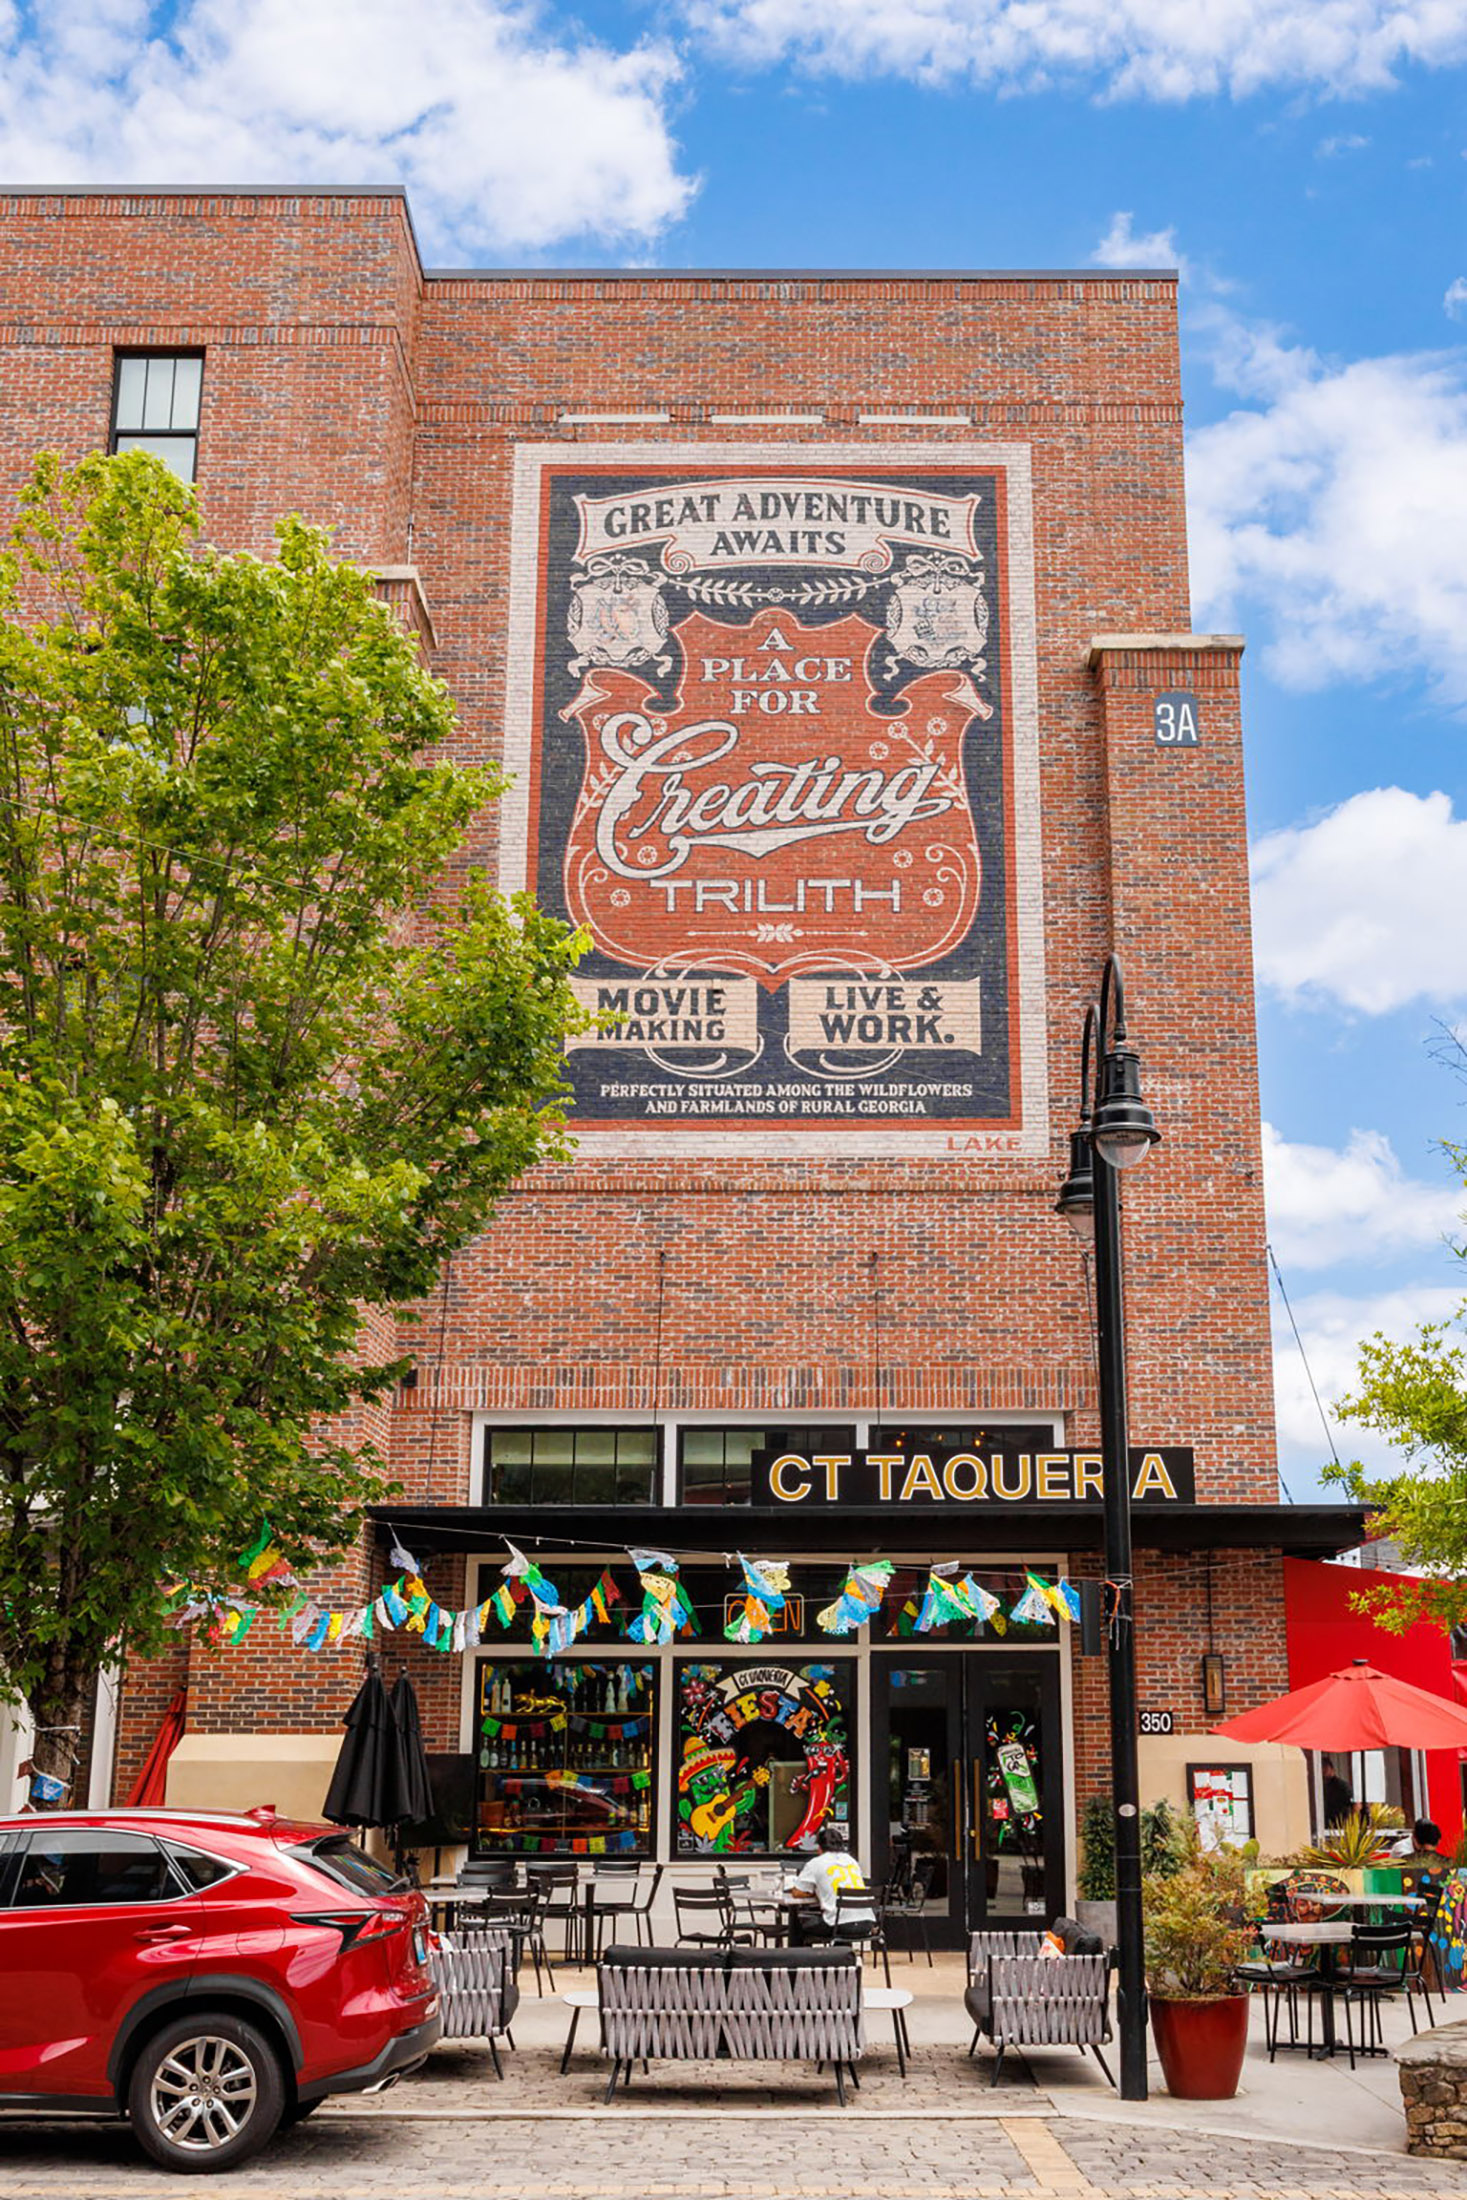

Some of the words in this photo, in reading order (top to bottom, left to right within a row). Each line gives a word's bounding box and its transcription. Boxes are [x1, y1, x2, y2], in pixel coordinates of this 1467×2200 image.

[604, 493, 721, 538] GREAT
[732, 492, 951, 539] ADVENTURE
[710, 530, 846, 555] AWAITS
[756, 627, 795, 651] A
[700, 657, 852, 682] PLACE
[730, 689, 821, 715] FOR
[1156, 703, 1197, 741] 3A
[595, 712, 954, 879] Creating
[649, 879, 901, 913] TRILITH
[597, 987, 727, 1016] MOVIE
[825, 986, 906, 1011] LIVE
[916, 986, 944, 1011] &
[597, 1020, 725, 1041] MAKING
[819, 1014, 955, 1044] WORK.
[600, 1083, 686, 1097] PERFECTLY
[688, 1083, 763, 1097] SITUATED
[766, 1084, 821, 1097] AMONG
[825, 1083, 855, 1096] THE
[858, 1083, 973, 1097] WILDFLOWERS
[645, 1101, 677, 1114] AND
[680, 1101, 775, 1114] FARMLANDS
[778, 1101, 798, 1114] OF
[801, 1101, 856, 1114] RURAL
[858, 1101, 927, 1114] GEORGIA
[947, 1136, 1022, 1151] LAKE
[769, 1454, 852, 1501] CT
[866, 1453, 1178, 1501] TAQUERA
[727, 1599, 801, 1632] ON
[709, 1690, 813, 1745] FIESTA
[1141, 1712, 1171, 1732] 350
